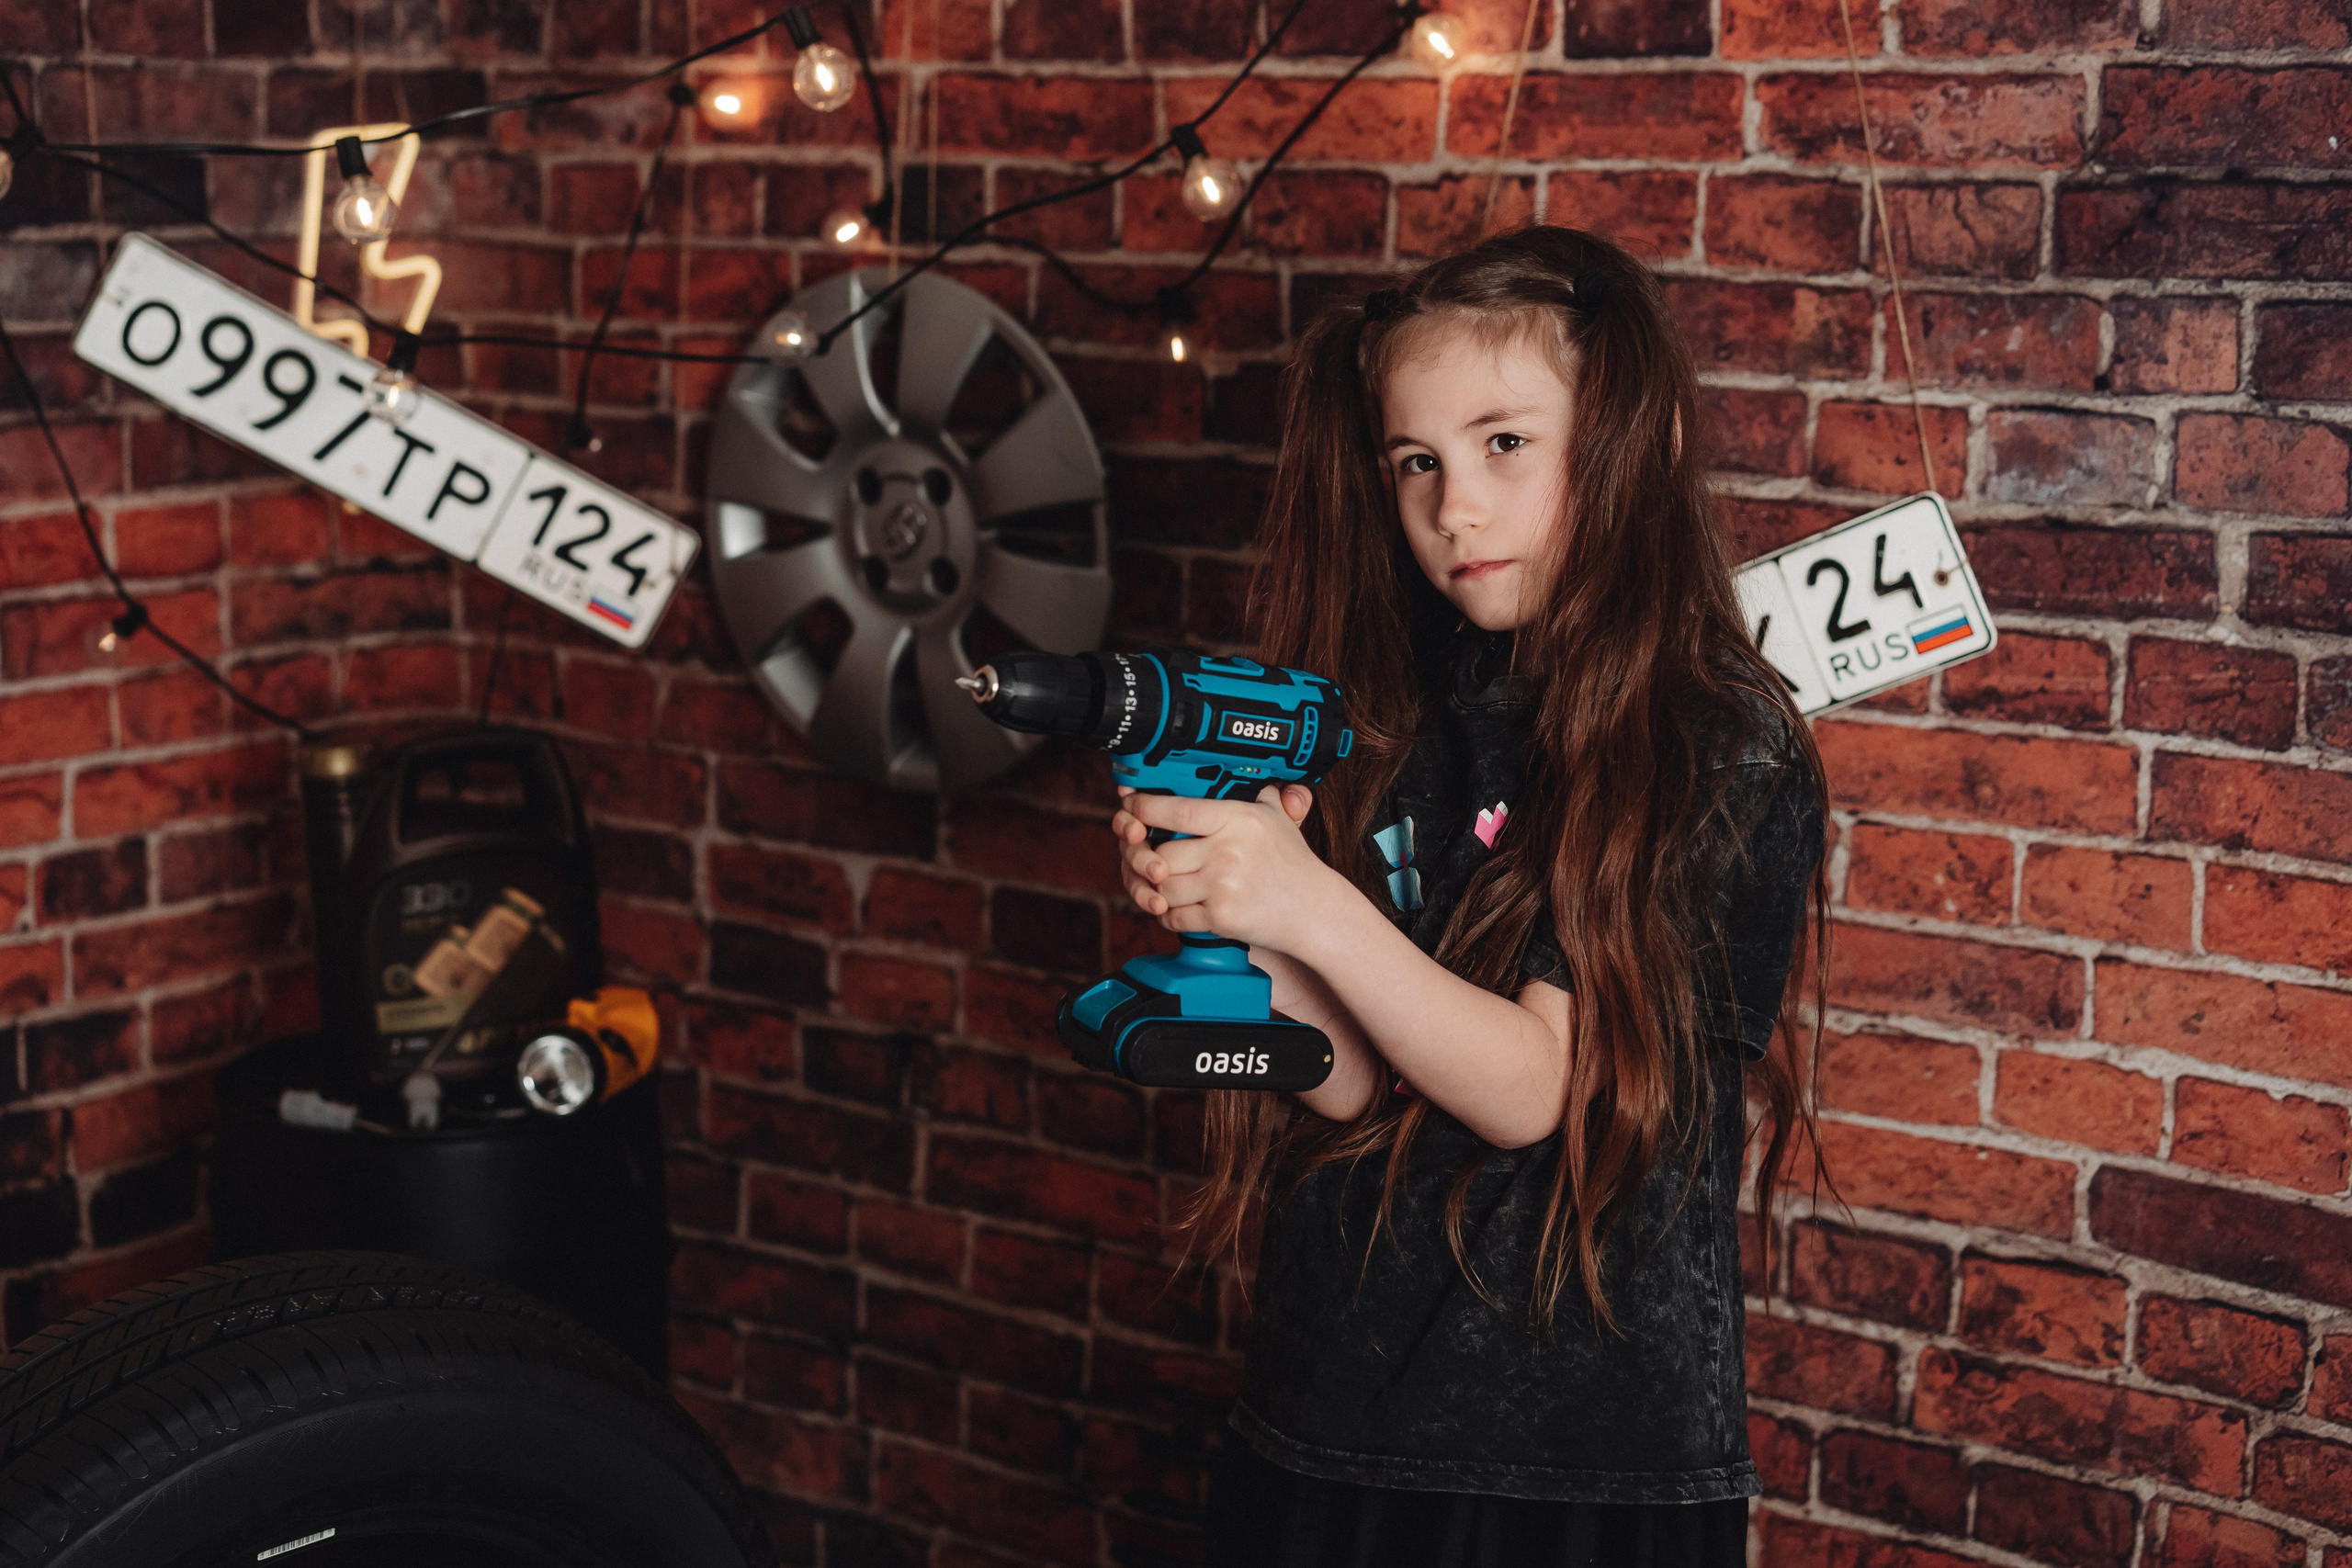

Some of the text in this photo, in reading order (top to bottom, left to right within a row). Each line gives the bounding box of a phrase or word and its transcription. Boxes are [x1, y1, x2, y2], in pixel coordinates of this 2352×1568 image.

[529, 486, 656, 597] 124
[1806, 534, 1924, 643] 24
[1830, 633, 1909, 682] RUS
[1124, 672, 1136, 687] 15
[1125, 697, 1137, 712] 13
[1118, 721, 1132, 732] 11
[1232, 720, 1280, 741] oasis
[1194, 1046, 1270, 1075] oasis
